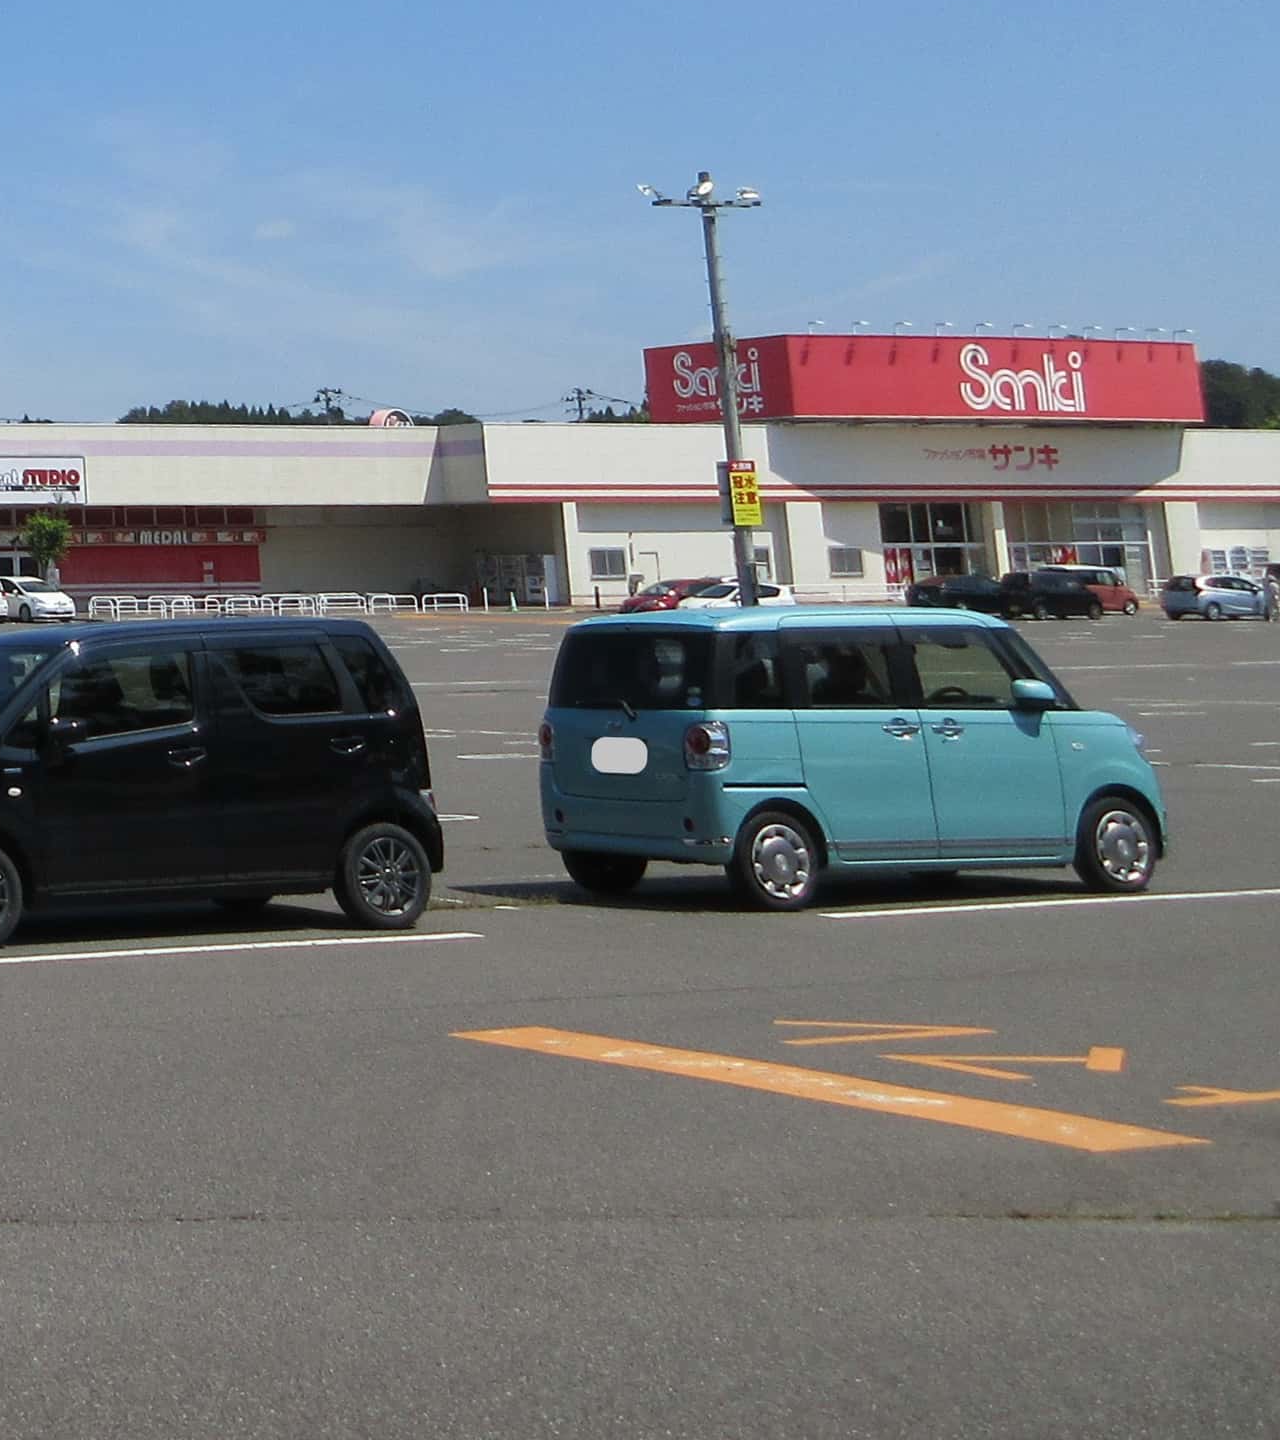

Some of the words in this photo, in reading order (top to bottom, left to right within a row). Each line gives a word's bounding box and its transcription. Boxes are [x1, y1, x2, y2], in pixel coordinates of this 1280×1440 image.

[673, 347, 761, 398] Saki
[960, 343, 1086, 412] Sanki
[989, 444, 1060, 471] サンキ
[22, 468, 81, 486] STUDIO
[140, 530, 190, 546] MEDAL
